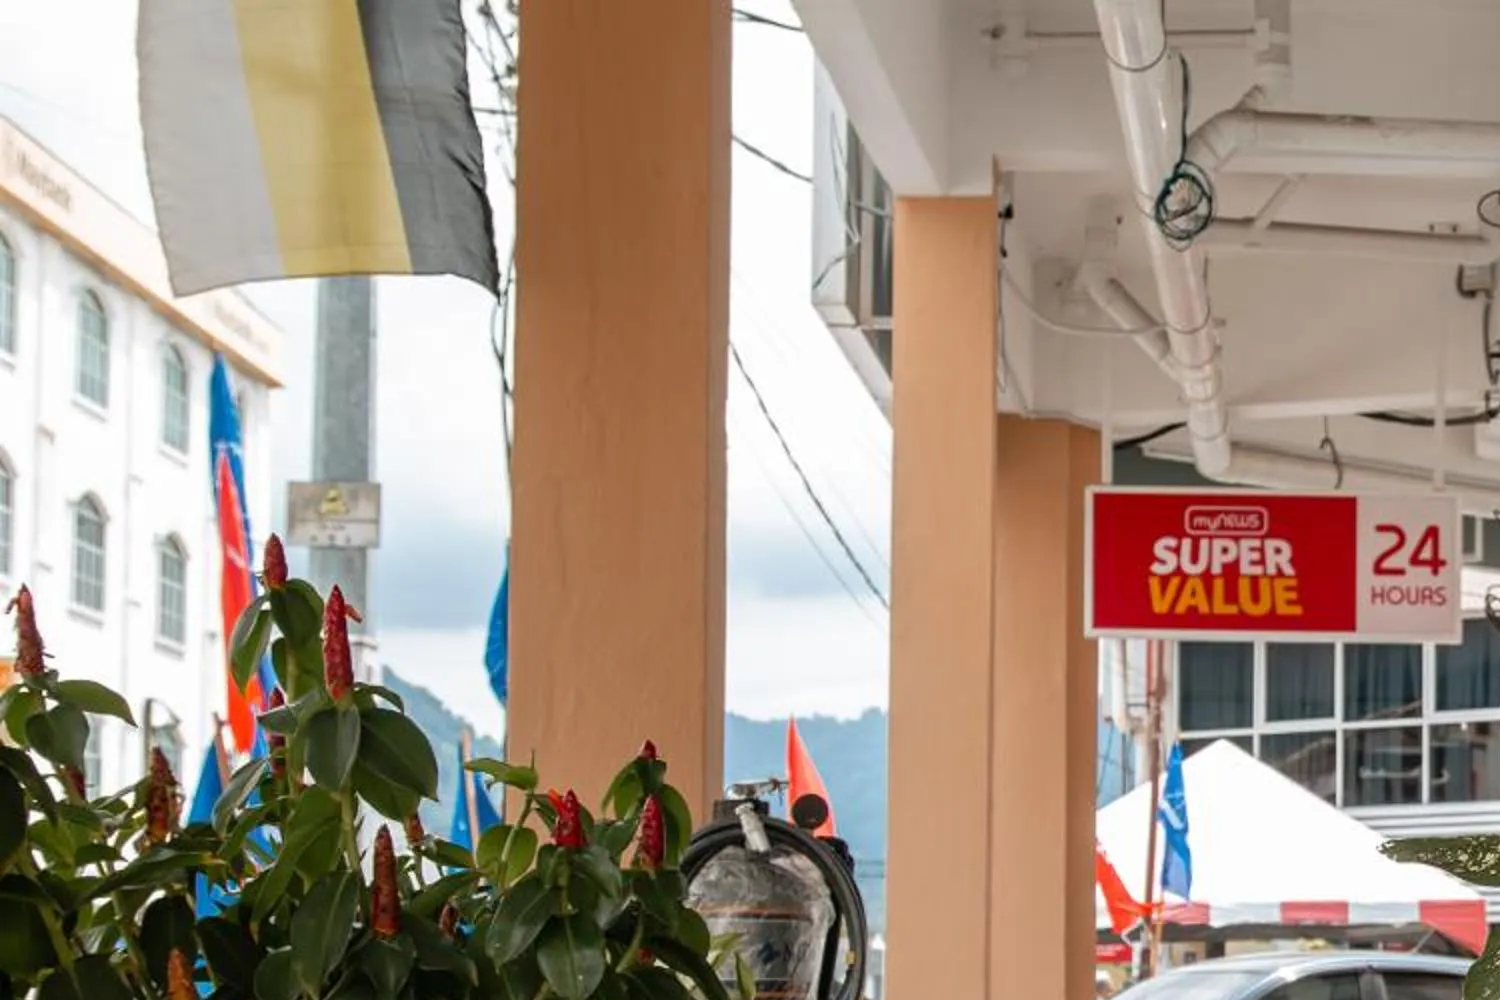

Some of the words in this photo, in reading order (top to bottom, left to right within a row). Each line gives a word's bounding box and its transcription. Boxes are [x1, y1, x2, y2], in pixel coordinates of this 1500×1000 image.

[1149, 536, 1295, 576] SUPER
[1371, 523, 1447, 576] 24
[1149, 576, 1303, 616] VALUE
[1371, 586, 1447, 605] HOURS
